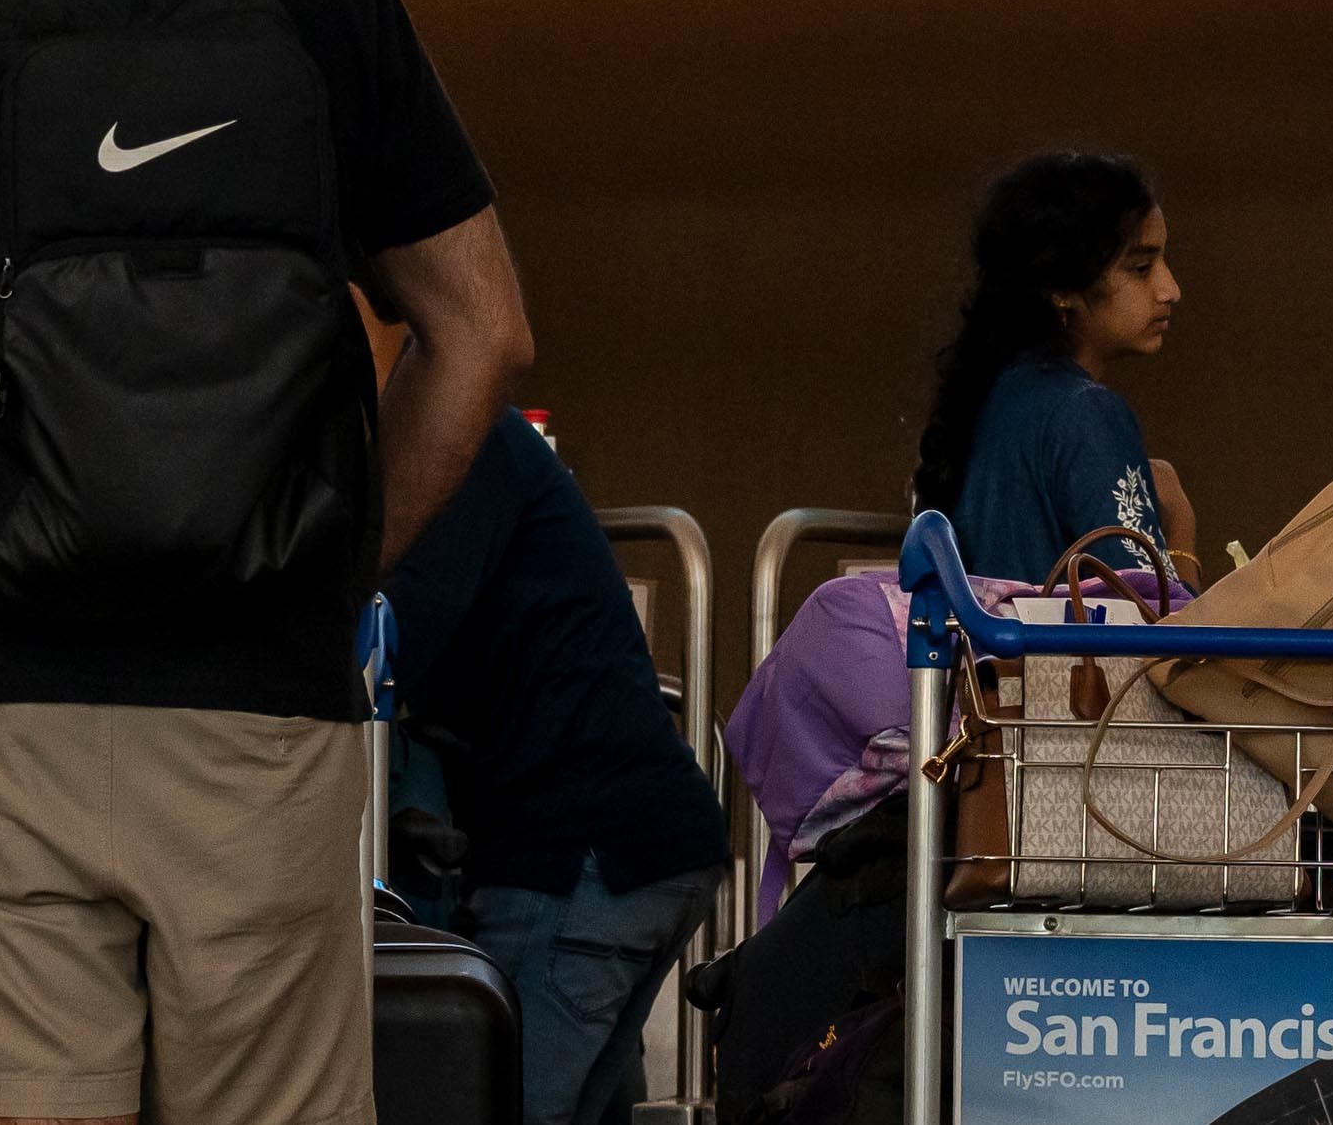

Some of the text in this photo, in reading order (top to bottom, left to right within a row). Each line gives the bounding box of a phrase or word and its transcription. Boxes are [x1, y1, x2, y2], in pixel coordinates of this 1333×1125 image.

[1003, 977, 1150, 998] WELCOME TO
[1004, 999, 1119, 1057] San
[1003, 1071, 1125, 1090] FlySFO.com
